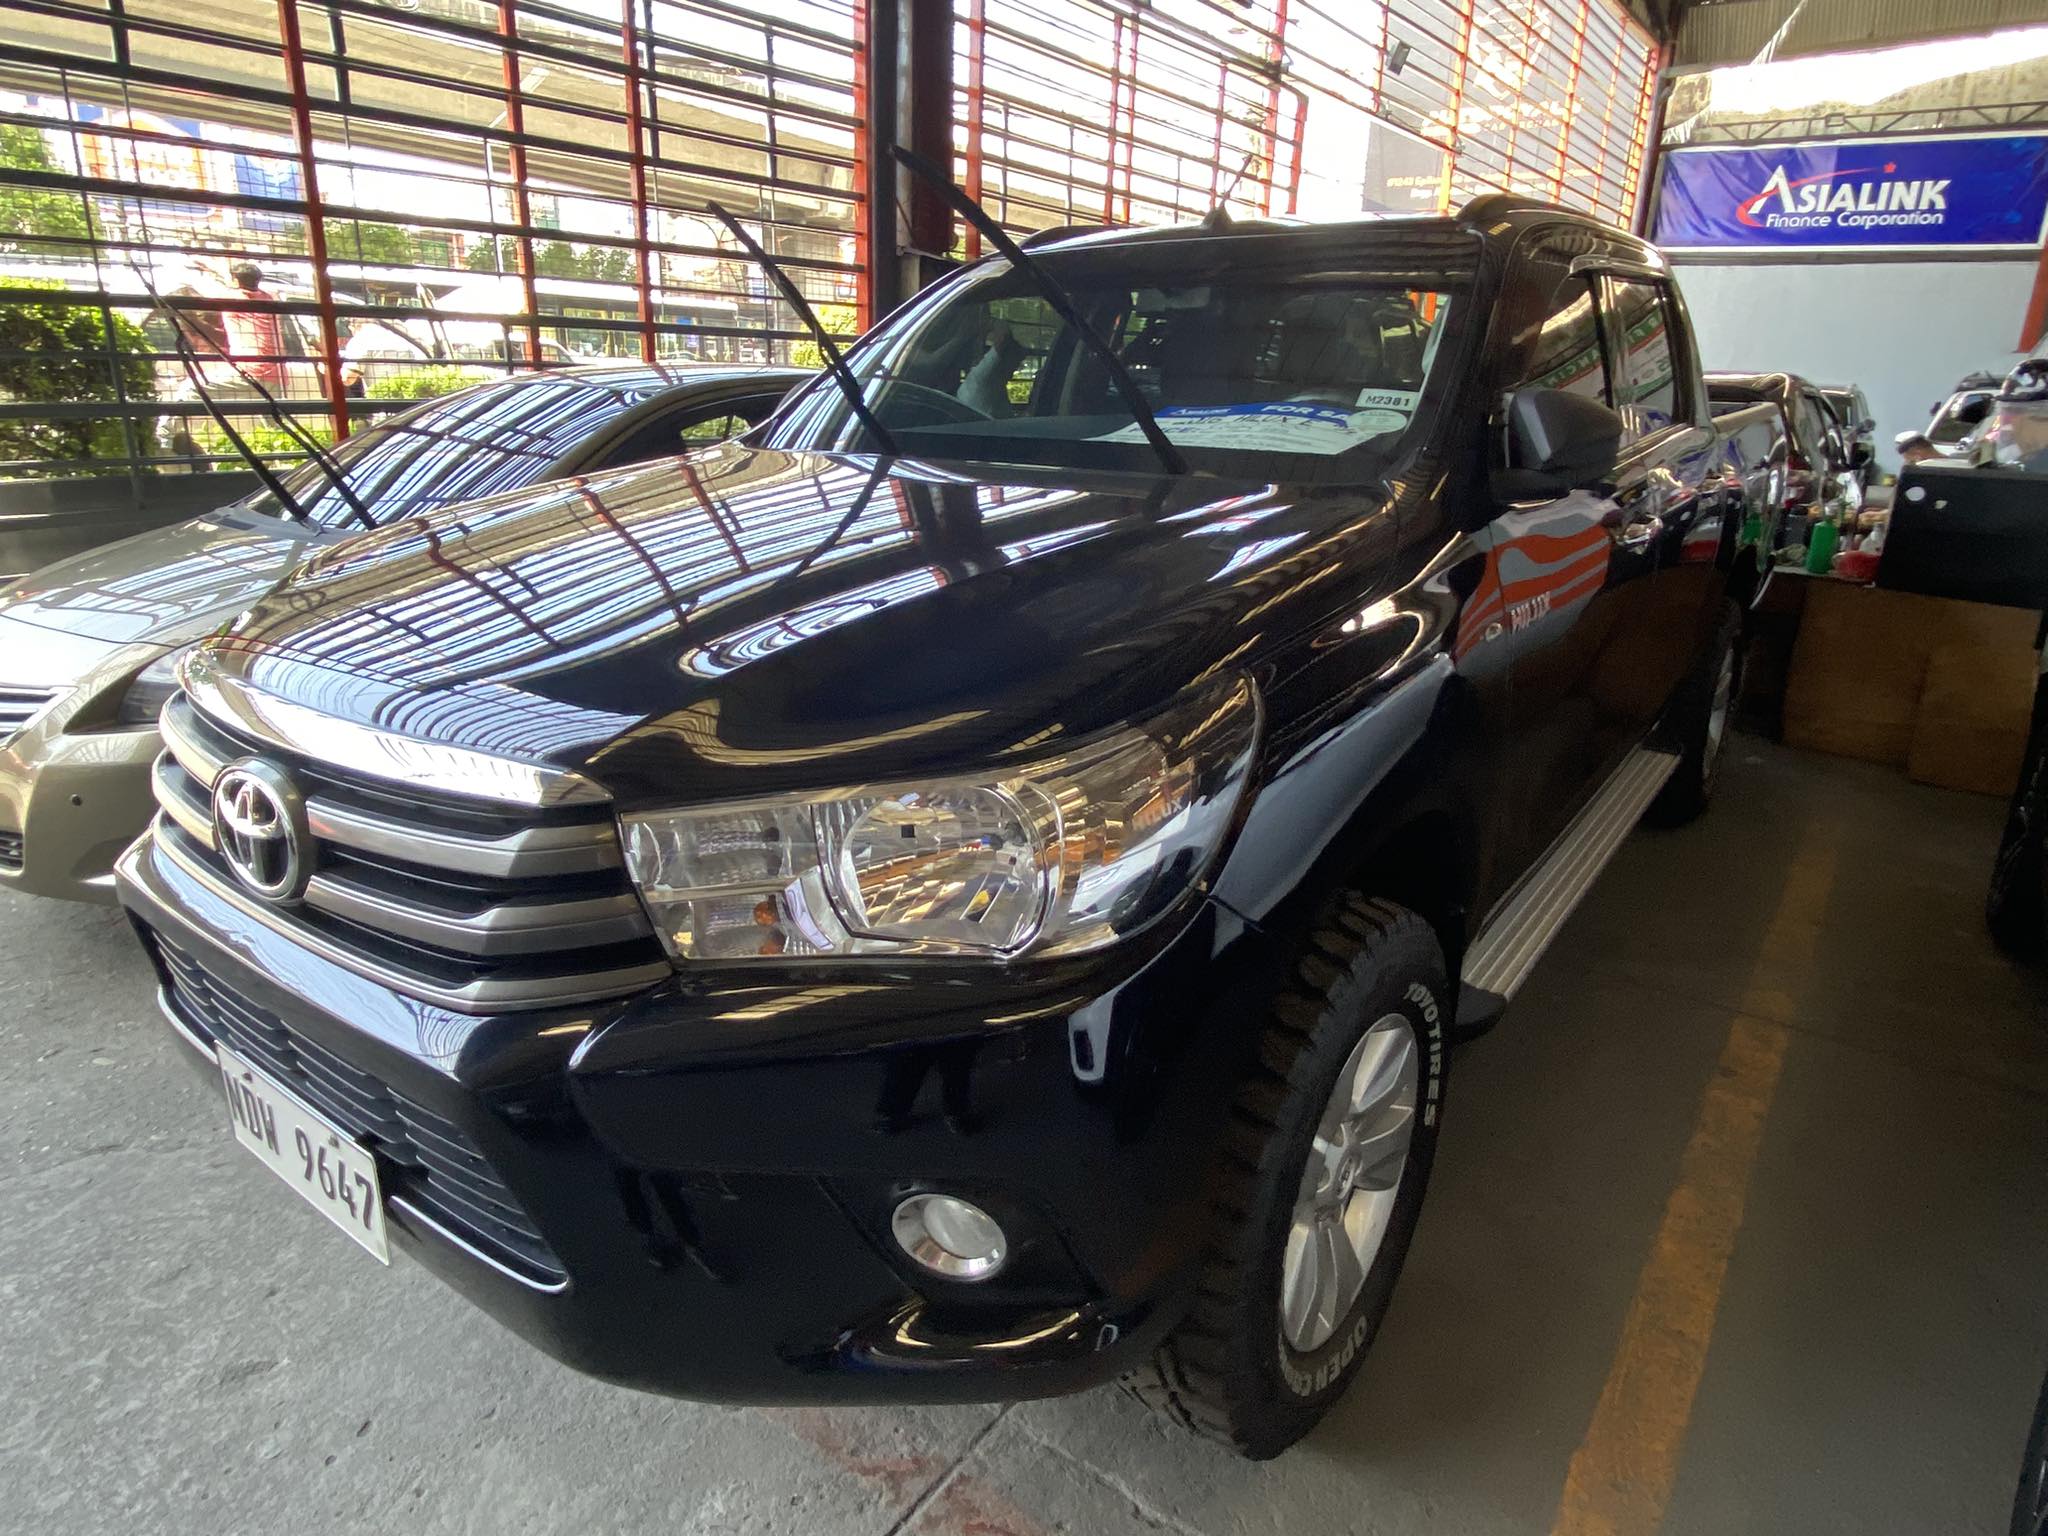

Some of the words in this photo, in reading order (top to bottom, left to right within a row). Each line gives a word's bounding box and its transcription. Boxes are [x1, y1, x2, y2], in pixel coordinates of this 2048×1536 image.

[1747, 164, 1951, 215] ASIALINK
[1766, 212, 1831, 228] Finance
[1837, 209, 1943, 230] Corporation
[1365, 395, 1410, 407] M2381
[1261, 405, 1314, 415] FOR
[1317, 410, 1350, 421] SA
[294, 1126, 375, 1231] 9647
